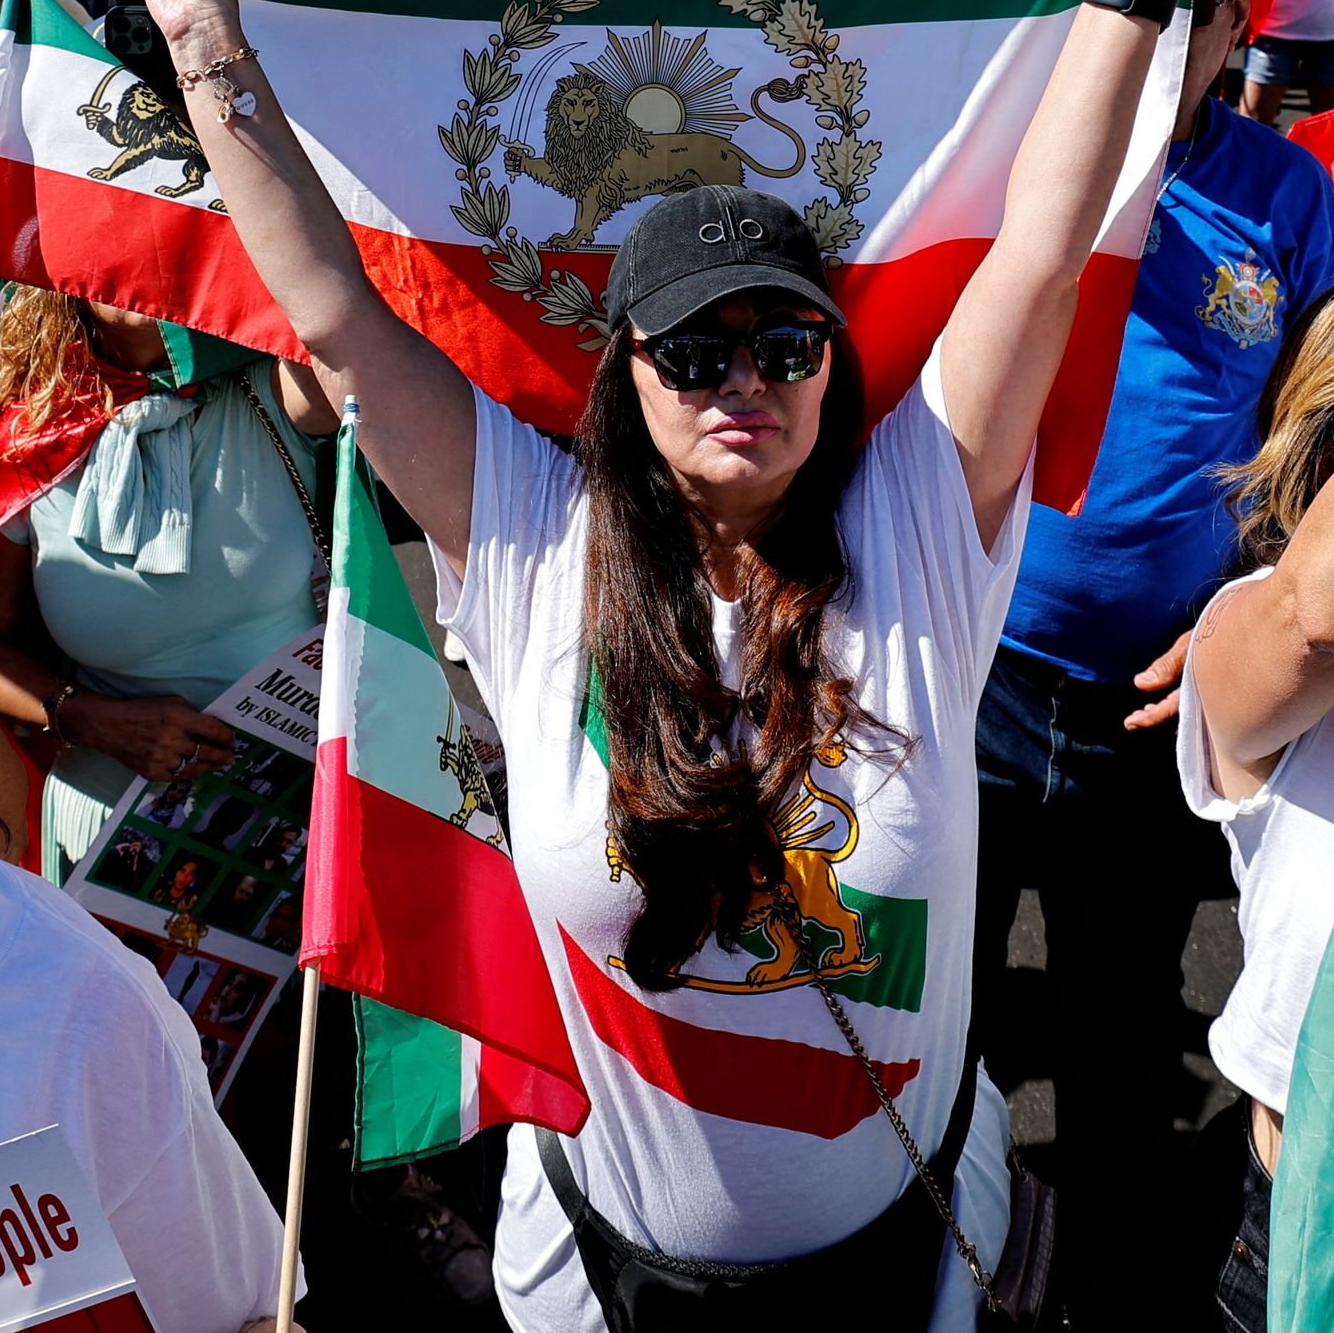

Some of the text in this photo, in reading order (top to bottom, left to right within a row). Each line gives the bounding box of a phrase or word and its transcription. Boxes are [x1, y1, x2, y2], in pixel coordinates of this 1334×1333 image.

[699, 206, 763, 244] alo
[235, 696, 318, 744] by ISLAMIC
